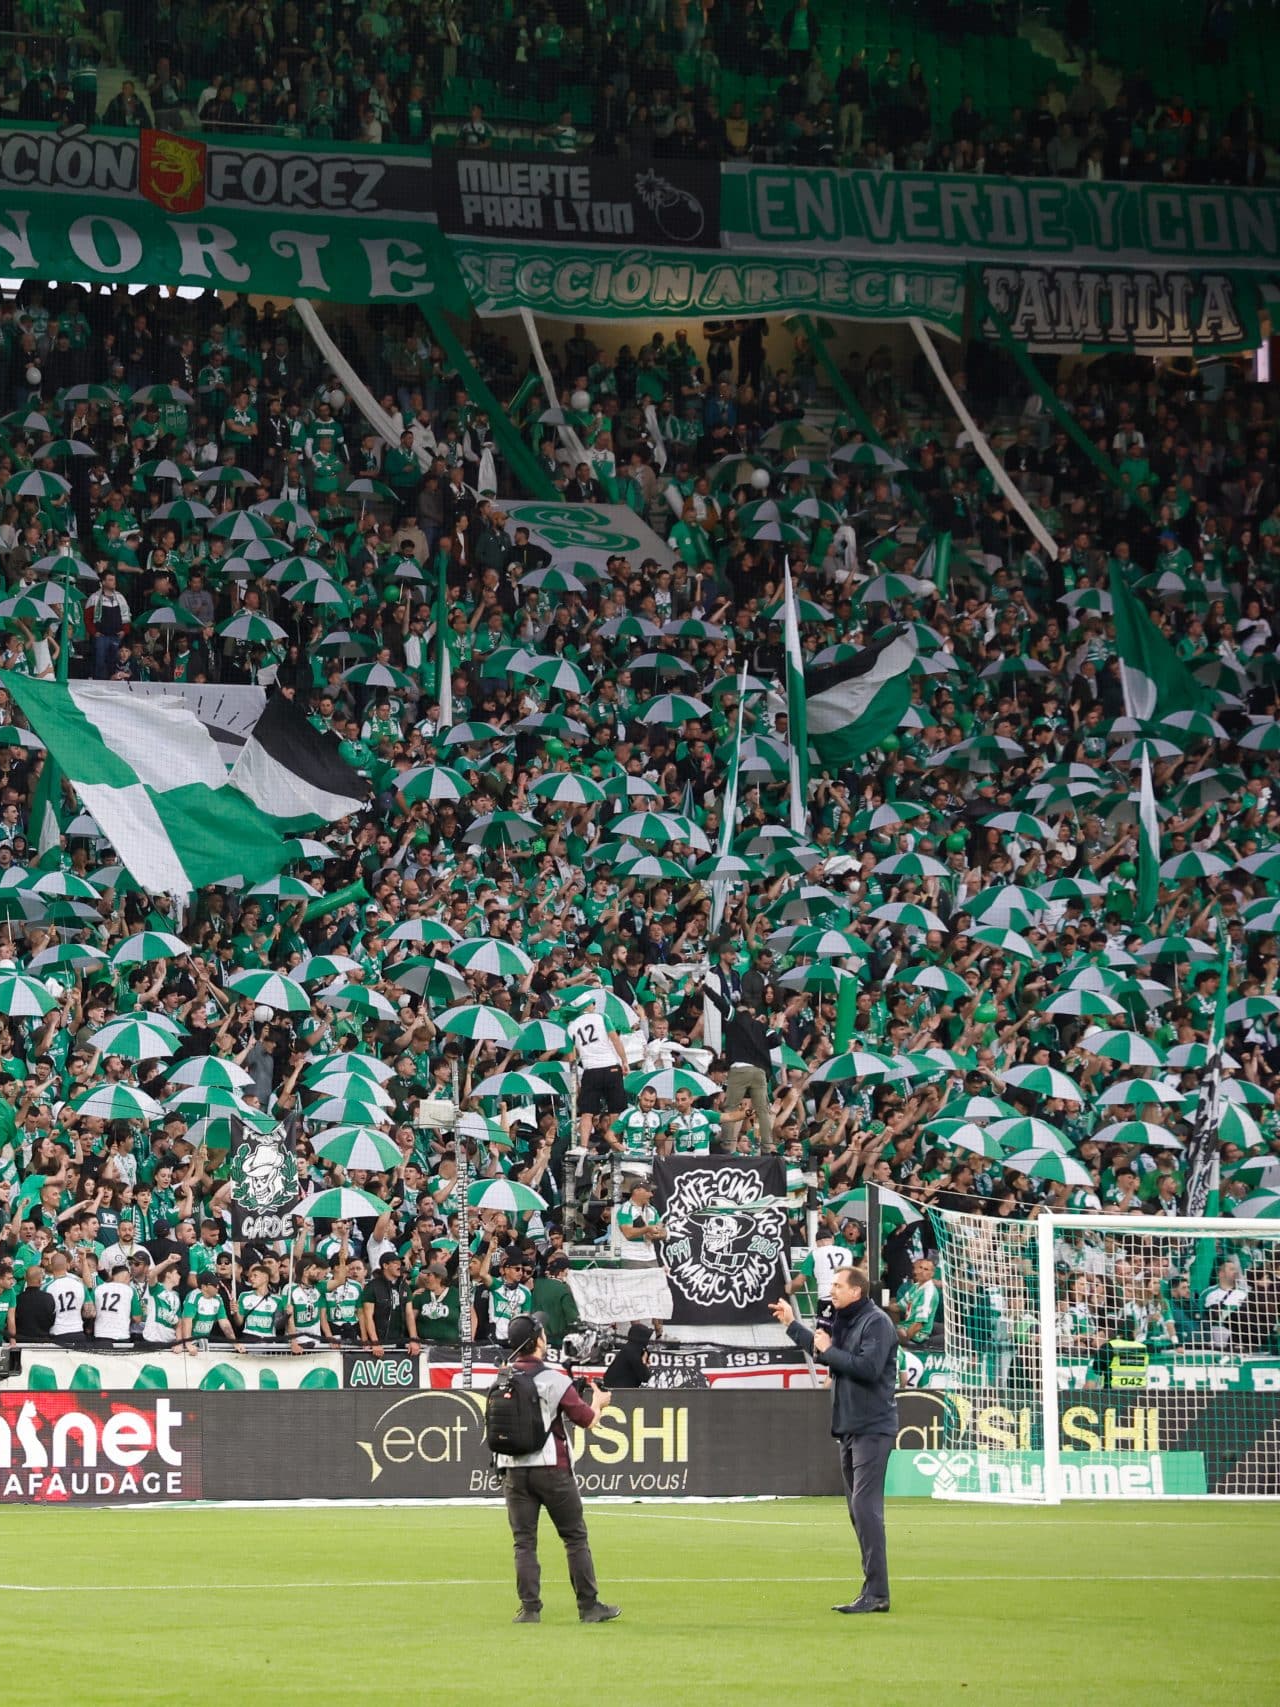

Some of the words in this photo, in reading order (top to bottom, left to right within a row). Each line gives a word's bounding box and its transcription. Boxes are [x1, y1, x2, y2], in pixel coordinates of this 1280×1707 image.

[209, 155, 387, 208] FOREZ
[458, 160, 590, 198] MUERTE
[463, 195, 542, 228] PARA
[757, 177, 835, 236] EN
[859, 179, 1072, 247] VERDE
[1088, 190, 1118, 245] Y
[1148, 193, 1280, 254] CON
[460, 251, 692, 302] SECCIÓN
[706, 259, 960, 312] ARDÈCHE
[982, 269, 1243, 343] FAMILIA
[577, 1024, 598, 1046] 12
[242, 1215, 294, 1239] GARDE
[674, 1256, 727, 1299] MAGIC
[731, 1256, 770, 1303] FANS
[58, 1292, 76, 1313] 12
[101, 1292, 120, 1312] 12
[350, 1359, 414, 1387] AVEC
[649, 1352, 708, 1367] OUEST
[726, 1352, 770, 1367] 1993
[382, 1416, 468, 1463] eat
[572, 1406, 689, 1464] SHI
[895, 1415, 944, 1451] at
[470, 1470, 503, 1491] Bie
[629, 1469, 688, 1491] vous!
